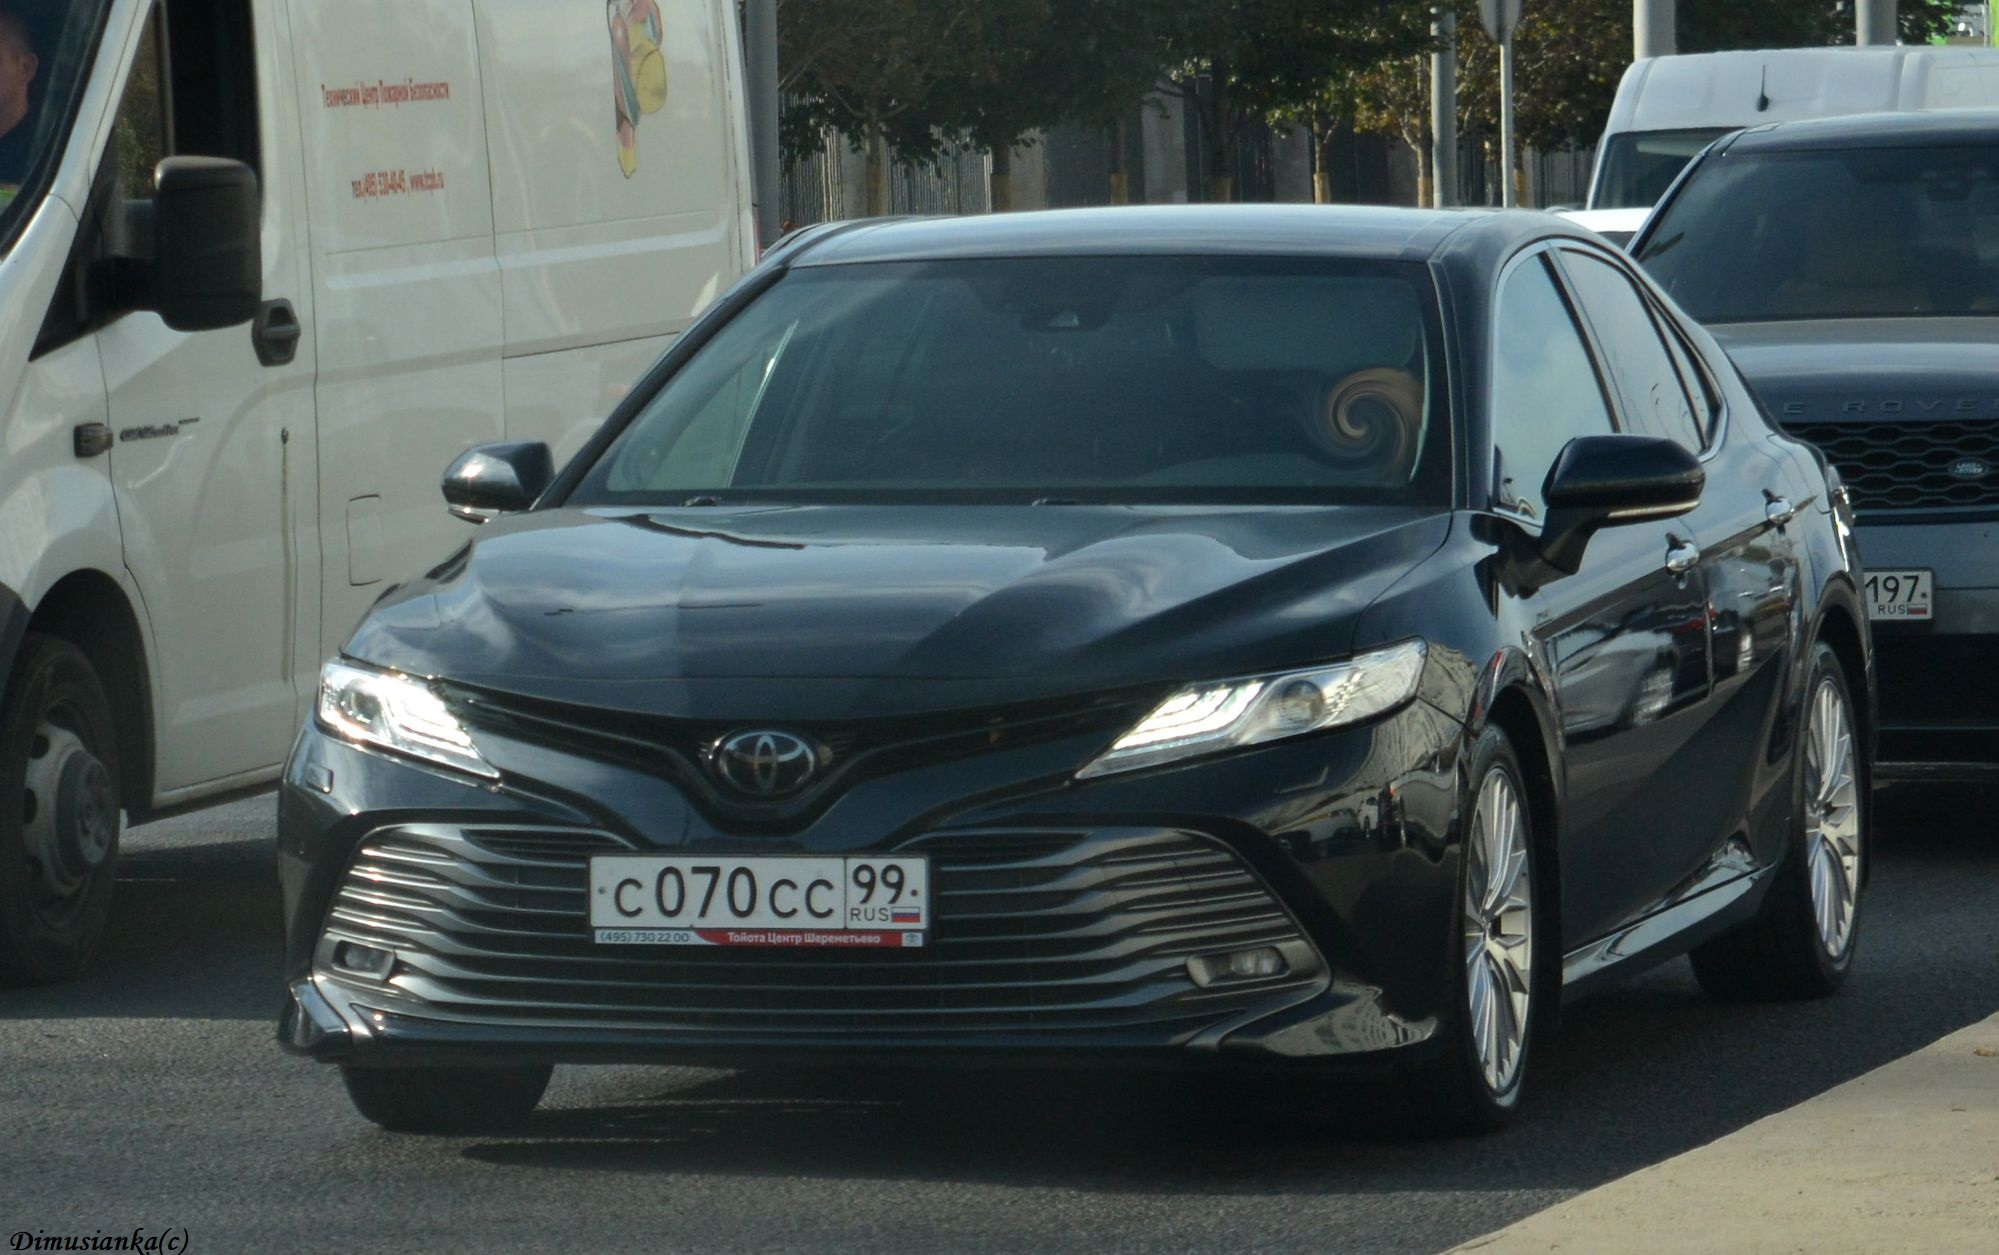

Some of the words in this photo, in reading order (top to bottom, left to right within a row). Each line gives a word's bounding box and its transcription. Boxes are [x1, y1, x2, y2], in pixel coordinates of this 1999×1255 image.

[1865, 575, 1919, 603] 197
[1878, 604, 1906, 615] RUS
[851, 863, 905, 905] 99
[850, 907, 890, 922] RUS
[600, 931, 631, 943] (495)
[634, 931, 655, 943] 730
[657, 931, 671, 943] 22
[727, 931, 765, 943] Тойота
[767, 932, 801, 945] Центр
[803, 932, 881, 945] Шереметьево
